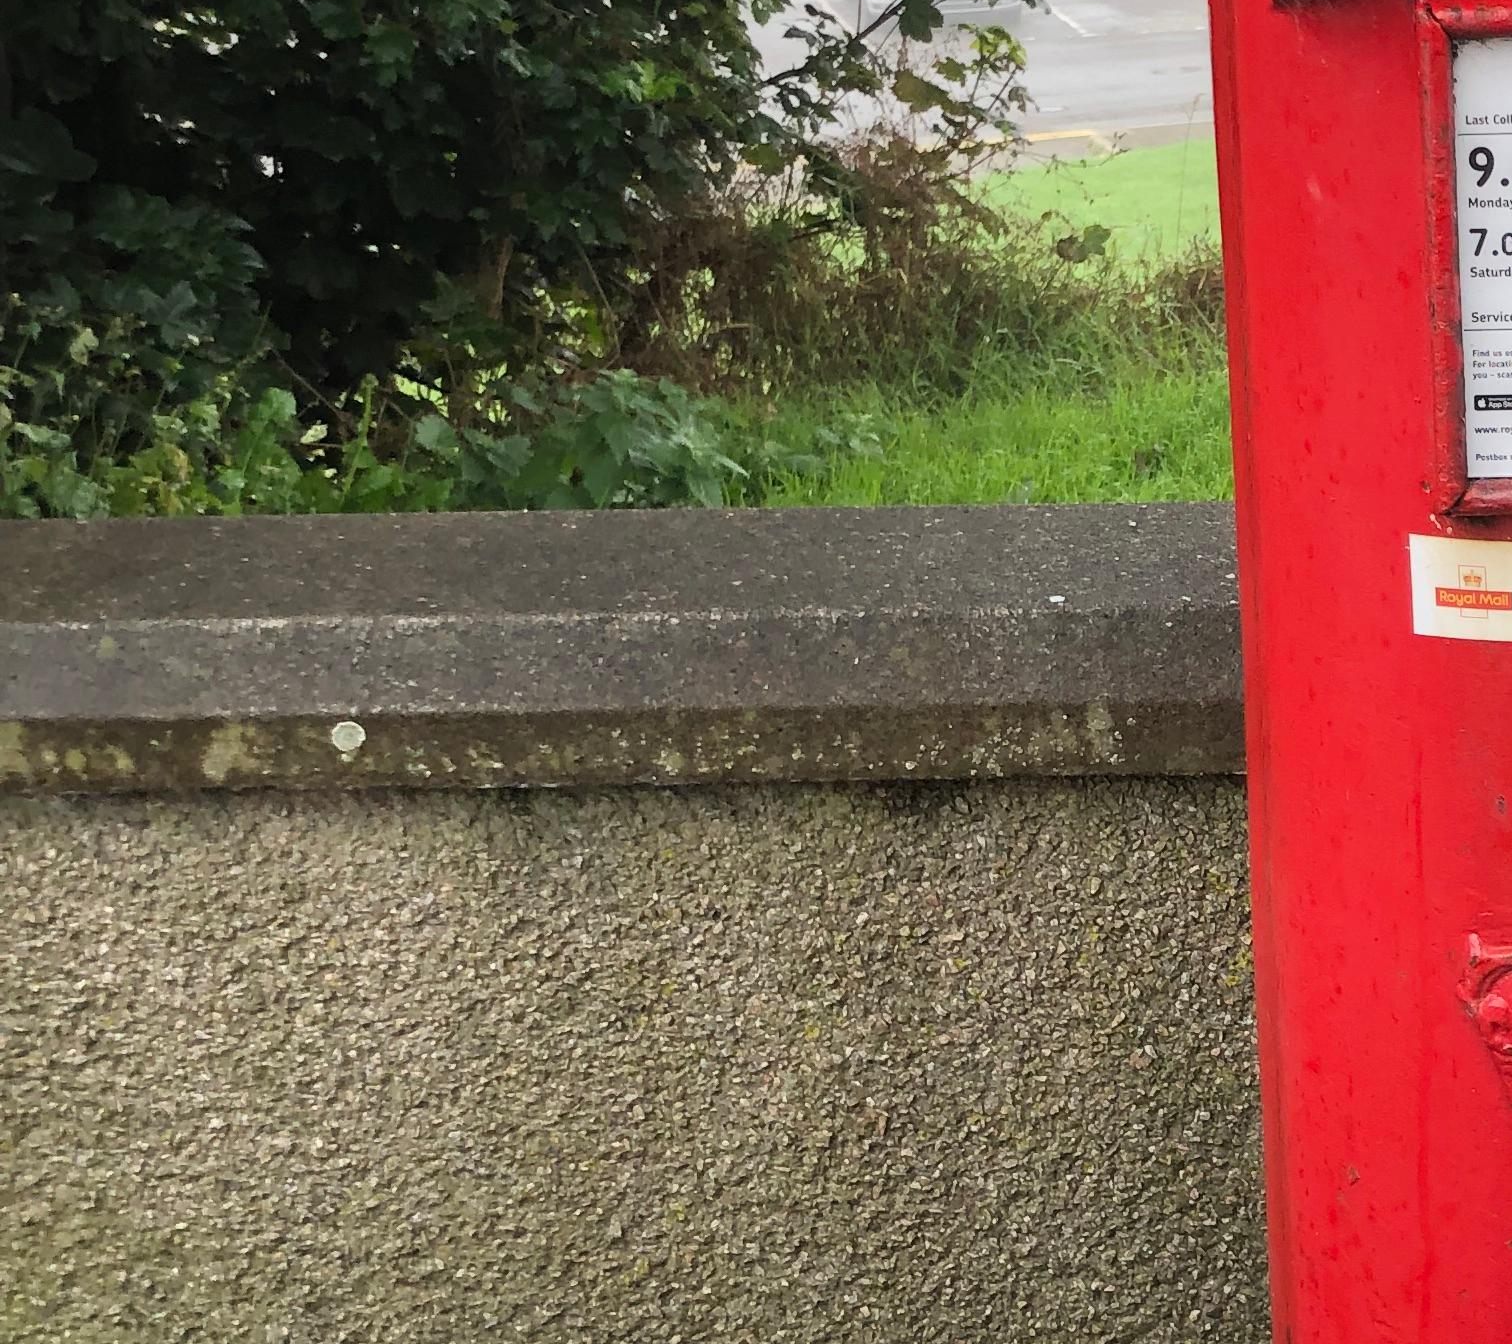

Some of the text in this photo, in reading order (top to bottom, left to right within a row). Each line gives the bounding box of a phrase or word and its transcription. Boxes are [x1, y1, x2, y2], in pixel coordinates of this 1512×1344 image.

[1465, 114, 1490, 125] Last
[1472, 349, 1490, 357] Find
[1472, 360, 1486, 368] For
[1472, 372, 1488, 380] you
[1488, 400, 1503, 409] App
[1475, 453, 1508, 461] Postbox
[1439, 590, 1509, 607] Royal Mail
